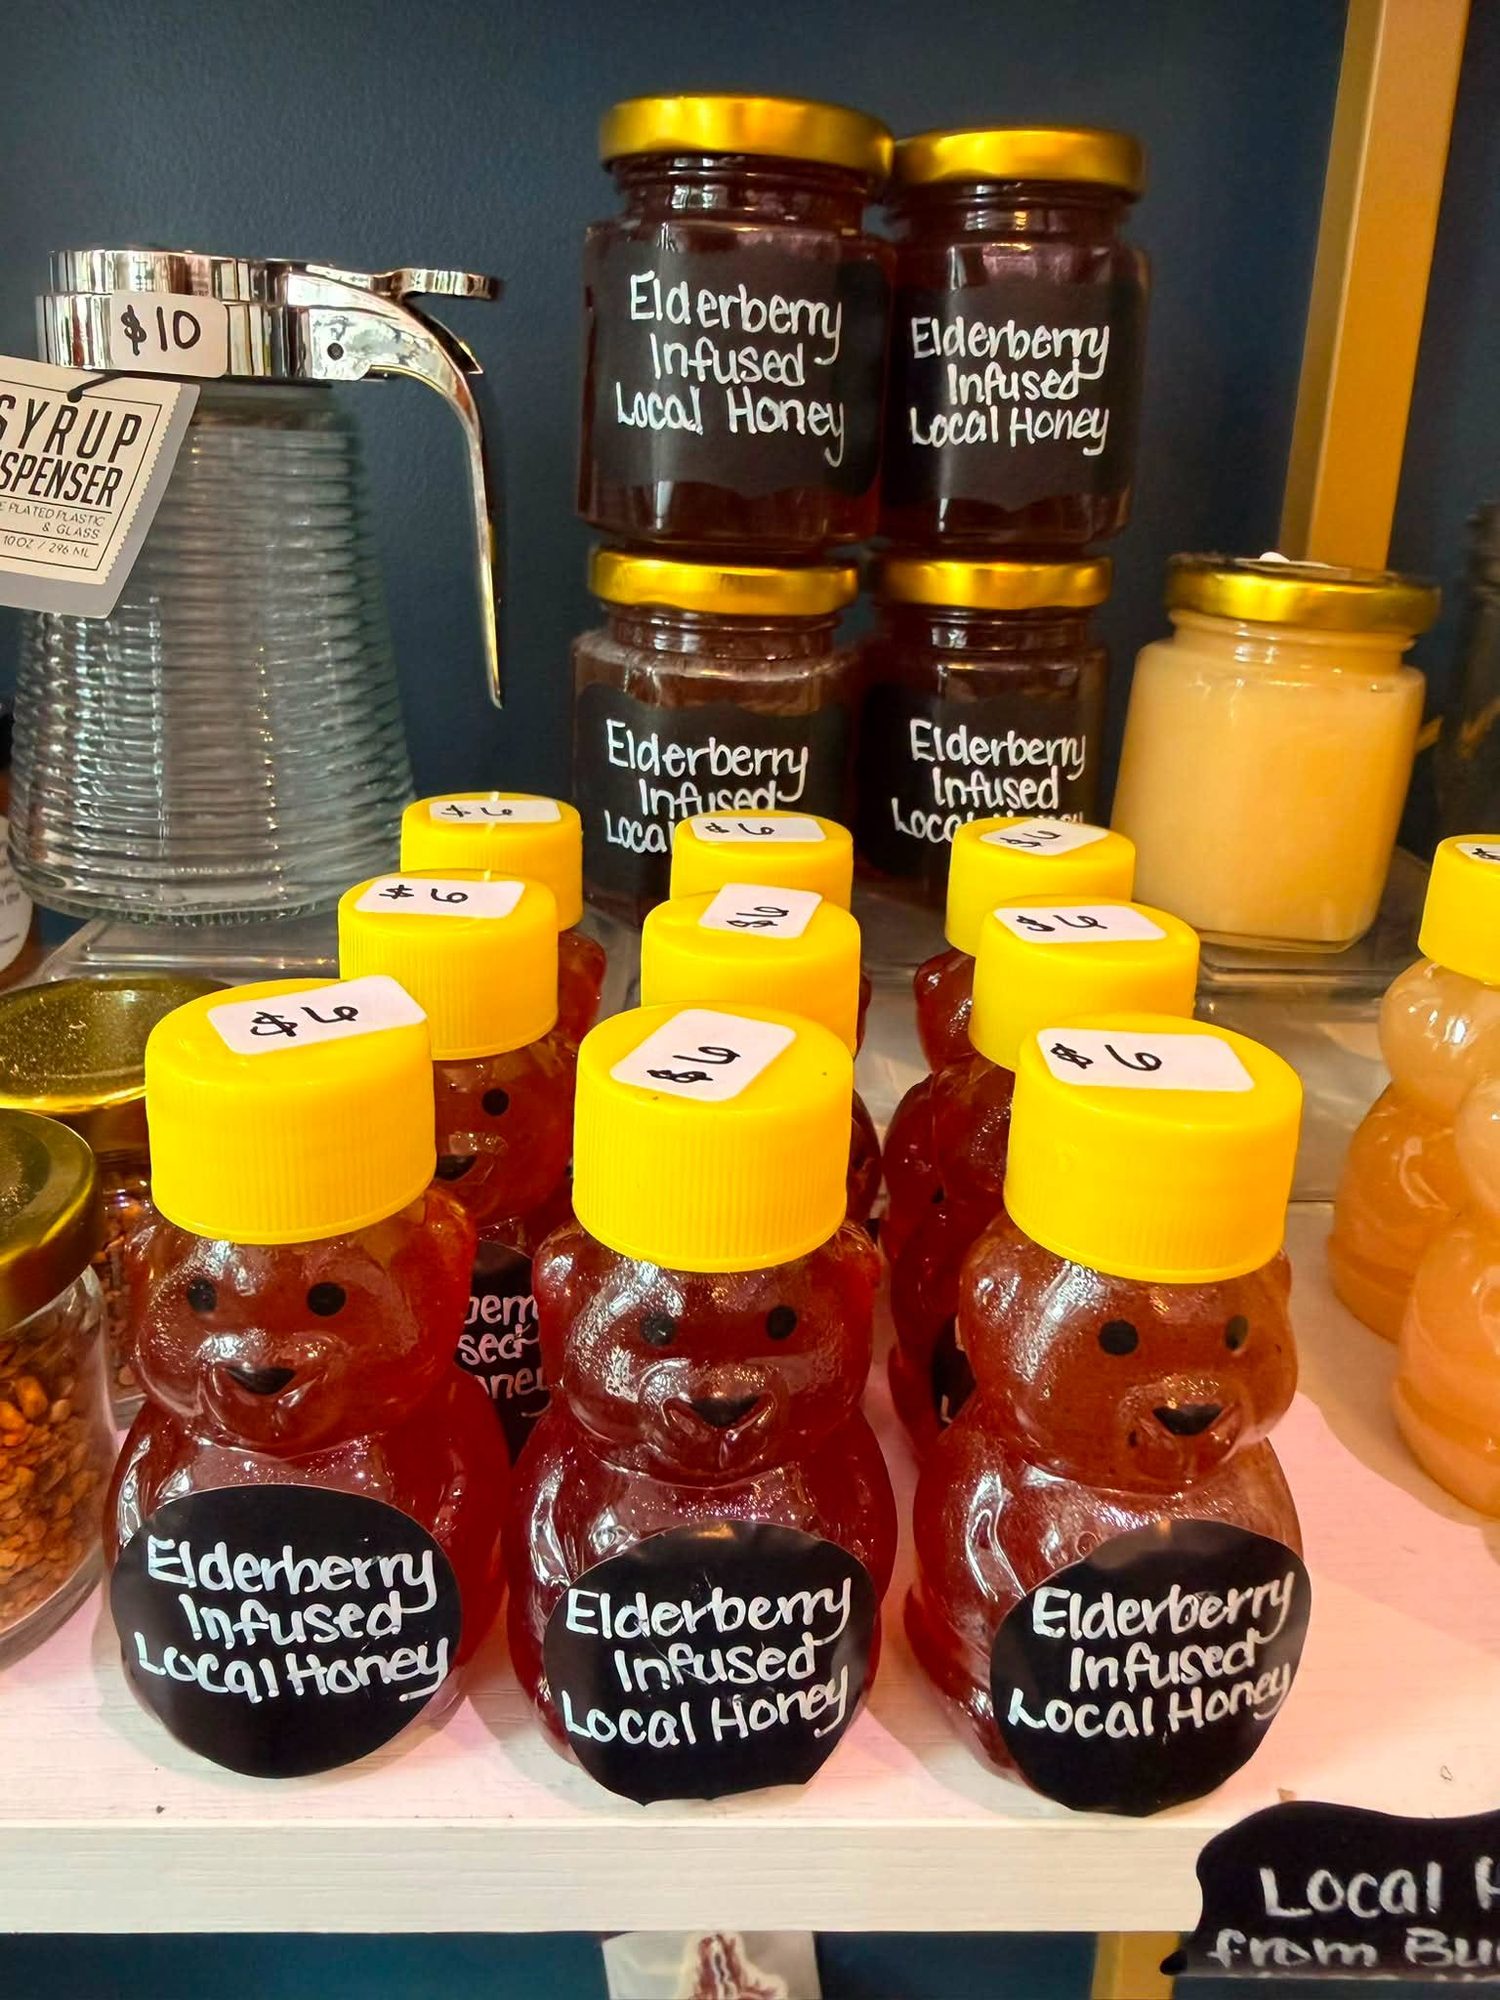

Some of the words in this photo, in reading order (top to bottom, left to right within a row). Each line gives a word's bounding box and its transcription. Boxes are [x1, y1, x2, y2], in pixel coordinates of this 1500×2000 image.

[121, 304, 201, 356] $10
[630, 270, 842, 365] Elderberry
[911, 316, 1110, 380] Elderberry
[650, 333, 804, 387] Infused
[947, 363, 1082, 406] Infused
[616, 381, 703, 435] Local
[727, 387, 845, 467] Honey
[909, 405, 999, 449] Local
[1009, 405, 1110, 456] Honey
[0, 450, 123, 507] SPENSER
[9, 501, 55, 519] PLATED
[56, 510, 105, 526] PLASTIC
[42, 521, 50, 532] &
[56, 523, 100, 539] GLASS
[606, 718, 808, 802] Elderberry
[910, 718, 1086, 781] Elderberry
[639, 778, 776, 819] Infused
[932, 765, 1059, 809] Infused
[148, 1534, 437, 1614] Elderberry
[179, 1590, 402, 1649] Infused
[565, 1577, 851, 1647] Elderberry
[1032, 1570, 1295, 1644] Elderberry
[134, 1631, 280, 1703] Local
[285, 1637, 448, 1702] Honey
[614, 1631, 818, 1692] Infused
[1069, 1628, 1262, 1693] Infused
[561, 1689, 697, 1748] Local
[710, 1664, 848, 1742] Honey
[1007, 1687, 1155, 1739] Local
[1167, 1662, 1292, 1733] Honey
[1259, 1860, 1442, 1919] Local
[1206, 1928, 1378, 1969] from
[1404, 1927, 1500, 1967] Bu
